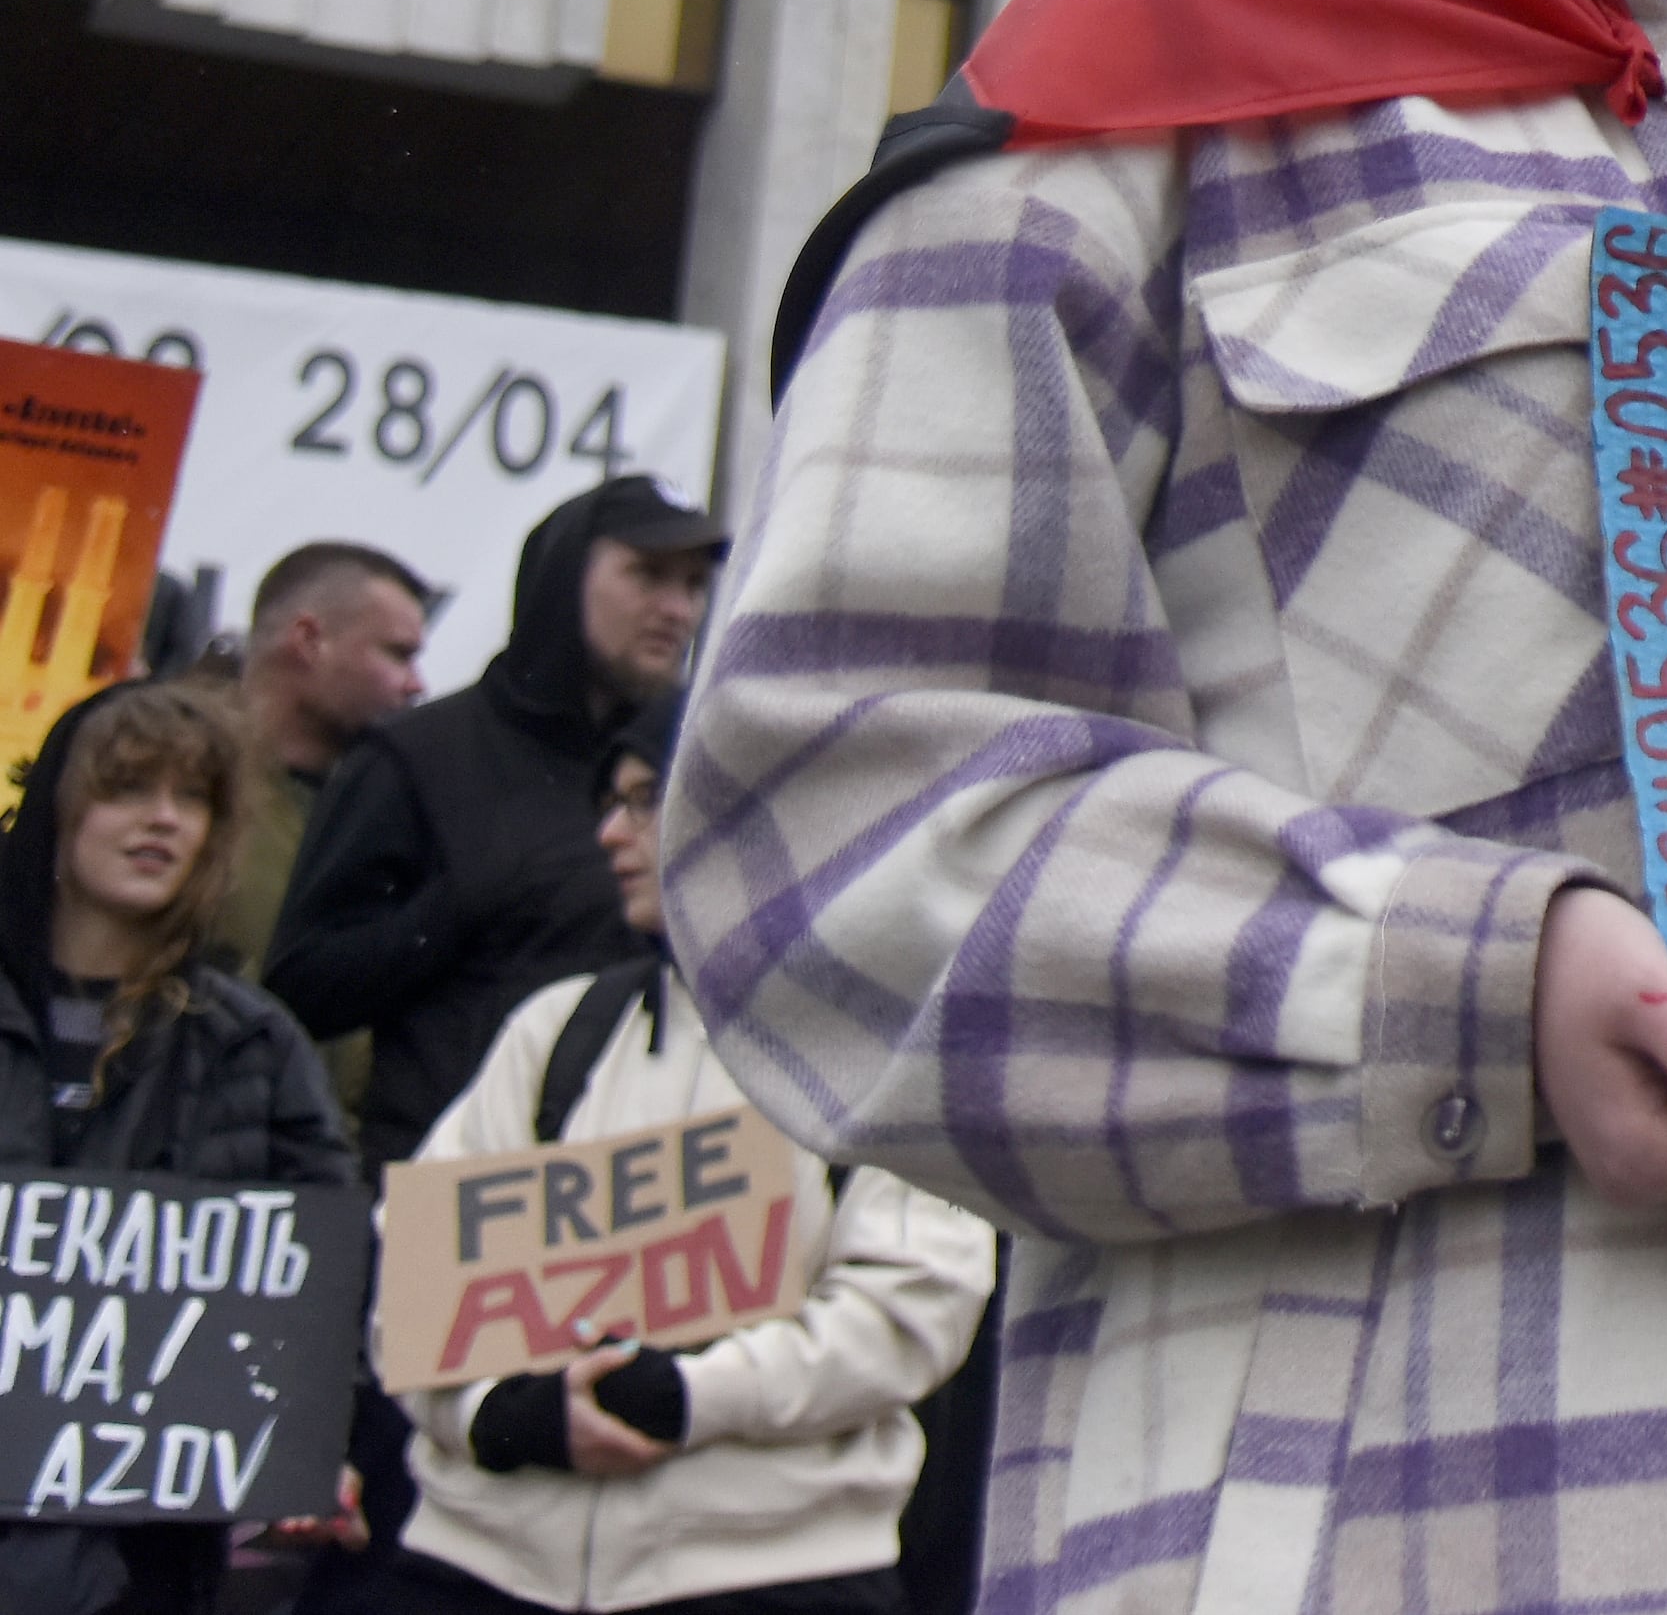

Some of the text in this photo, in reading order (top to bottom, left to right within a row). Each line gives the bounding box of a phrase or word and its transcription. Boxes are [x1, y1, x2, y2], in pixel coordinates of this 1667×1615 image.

[289, 348, 631, 486] 28/04
[456, 1114, 750, 1265] FREE
[436, 1193, 796, 1373] AZOV
[0, 1291, 208, 1416] МА!
[24, 1420, 280, 1517] AZOV
